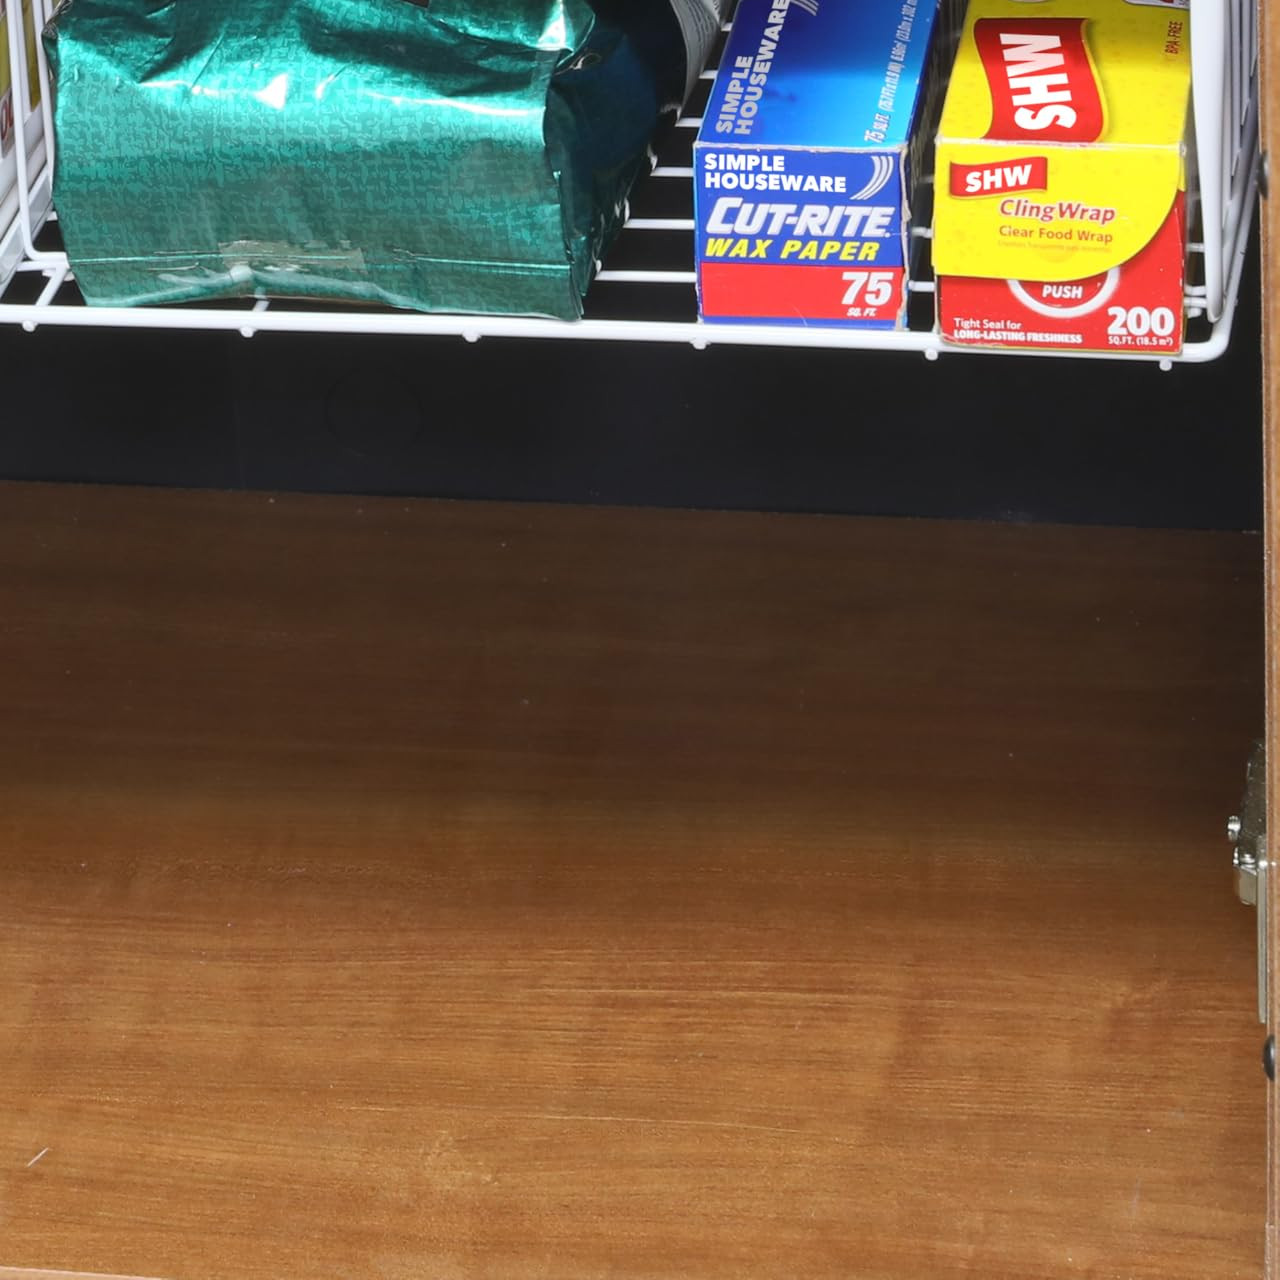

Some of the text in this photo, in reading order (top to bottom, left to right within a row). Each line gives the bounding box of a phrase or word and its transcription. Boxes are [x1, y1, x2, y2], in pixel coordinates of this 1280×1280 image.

[999, 33, 1077, 130] SHW
[716, 56, 754, 134] SIMPLE
[863, 129, 886, 144] 75
[704, 153, 785, 171] SIMPLE
[705, 172, 847, 193] HOUSEWARE
[965, 164, 1032, 193] SHW
[999, 225, 1113, 246] Clear Food Wrap
[705, 237, 880, 261] WAX PAPER
[841, 271, 895, 307] 75
[1042, 284, 1083, 299] PUSH
[953, 318, 1021, 330] Tight Seal for
[1107, 306, 1175, 337] 200
[953, 329, 1083, 344] LONG-LASTING FRESHNESS
